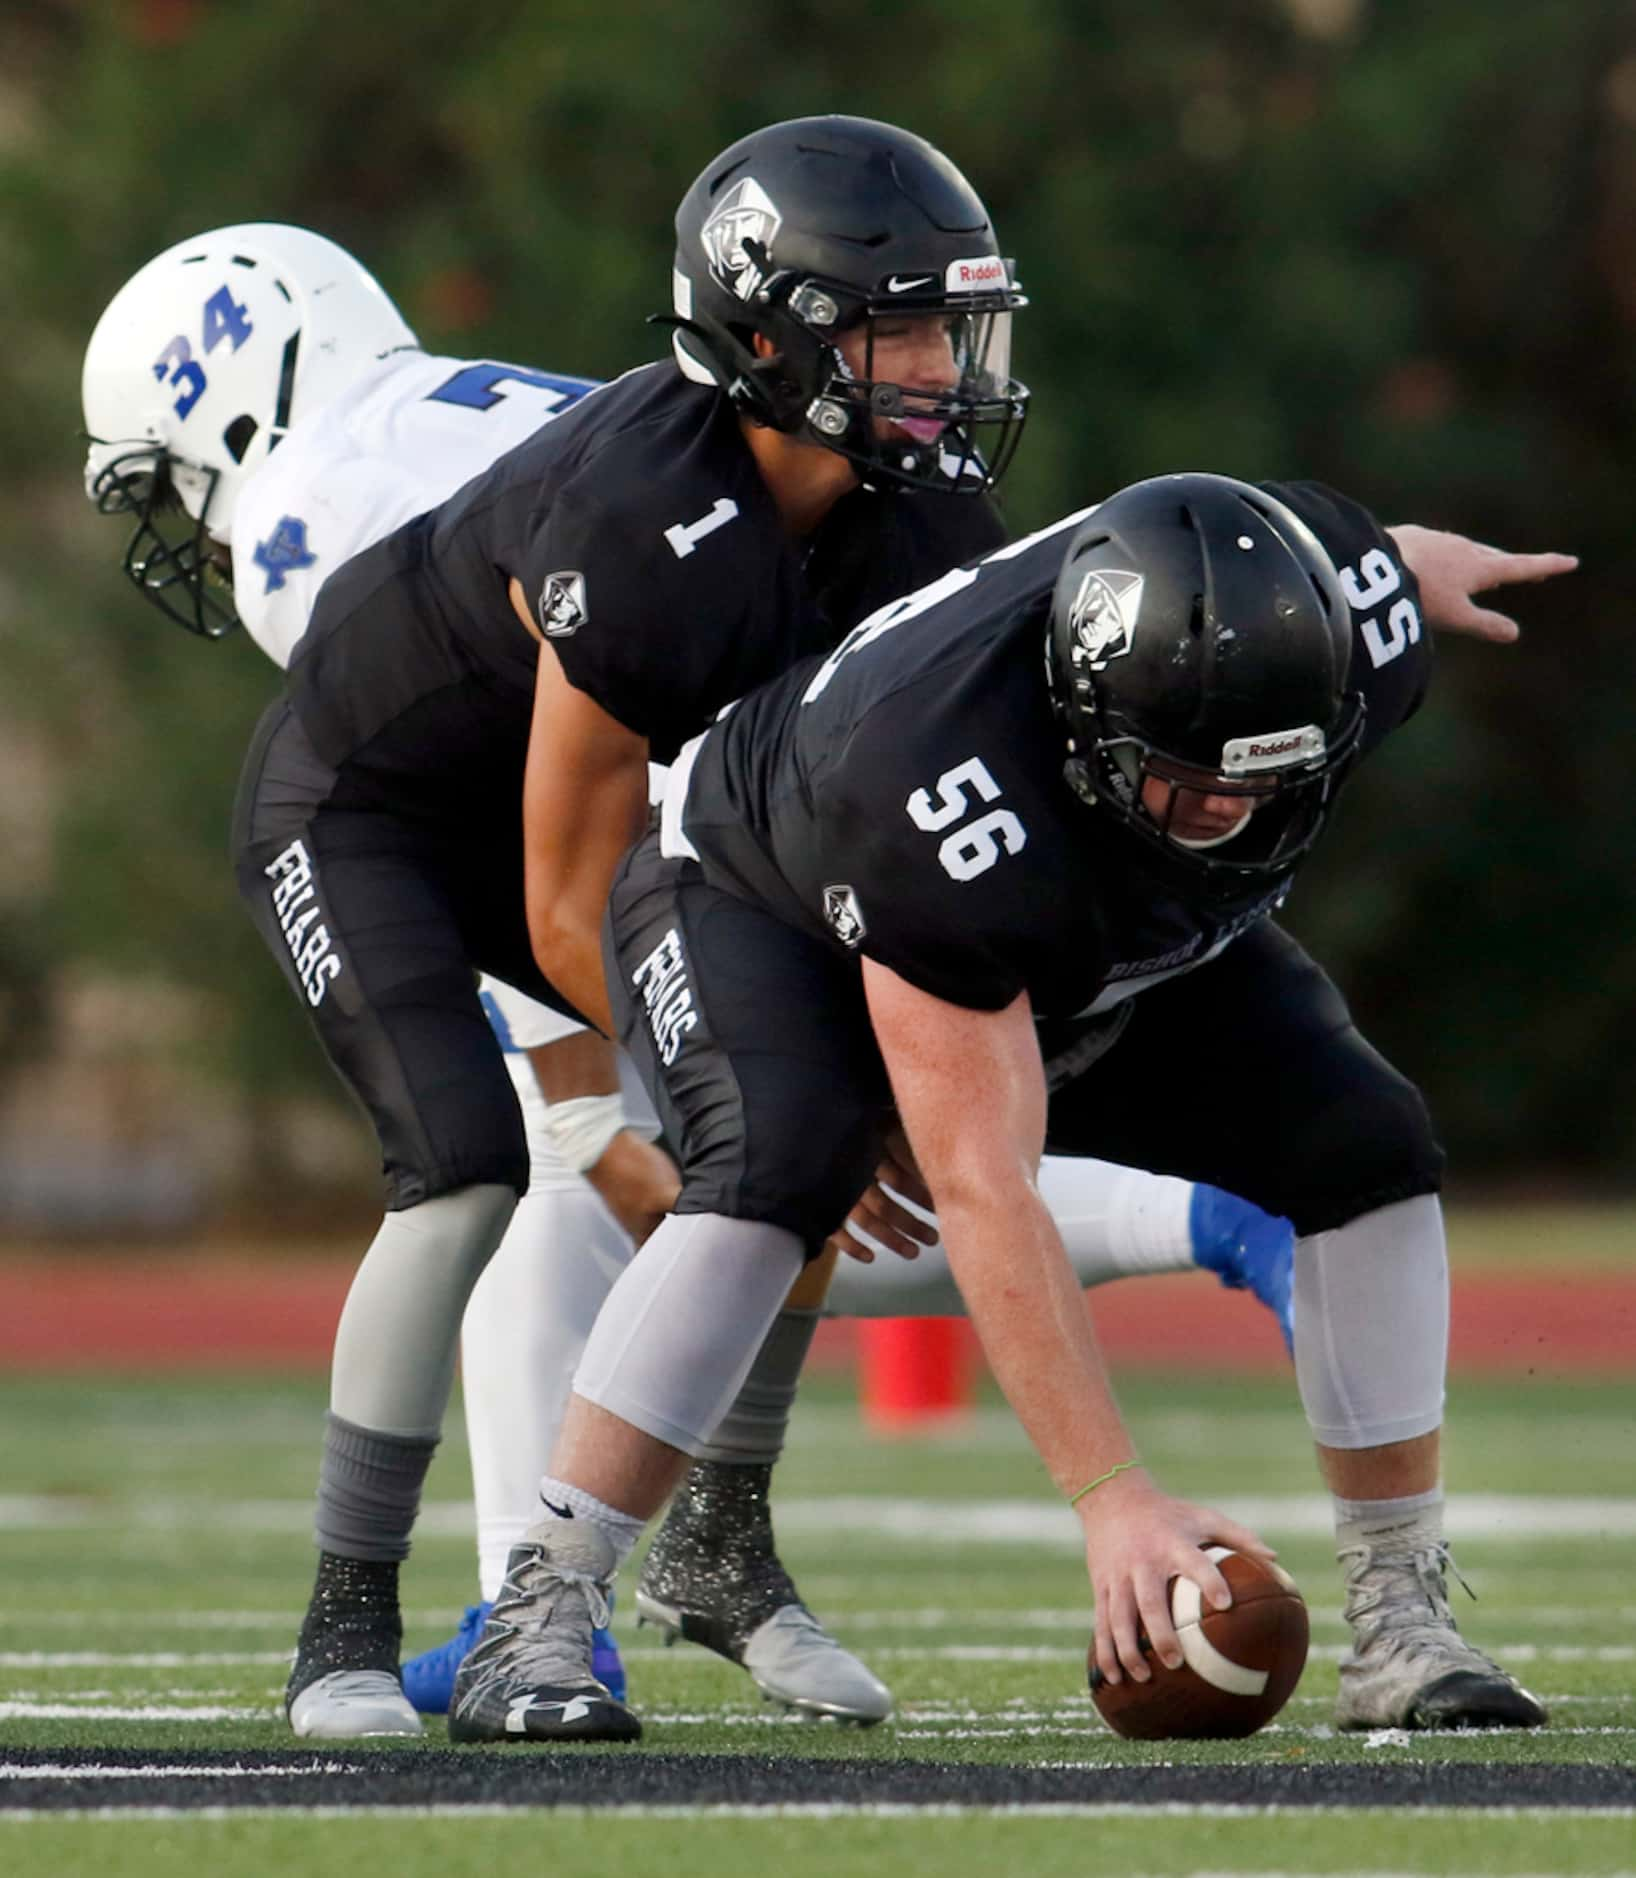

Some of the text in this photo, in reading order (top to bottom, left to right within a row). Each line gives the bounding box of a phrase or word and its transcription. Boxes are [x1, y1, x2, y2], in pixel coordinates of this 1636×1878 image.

[152, 284, 253, 422] 34
[664, 497, 739, 559] 1
[1339, 547, 1420, 669] 56
[905, 756, 1027, 882] 56
[264, 839, 341, 1007] FRIARS
